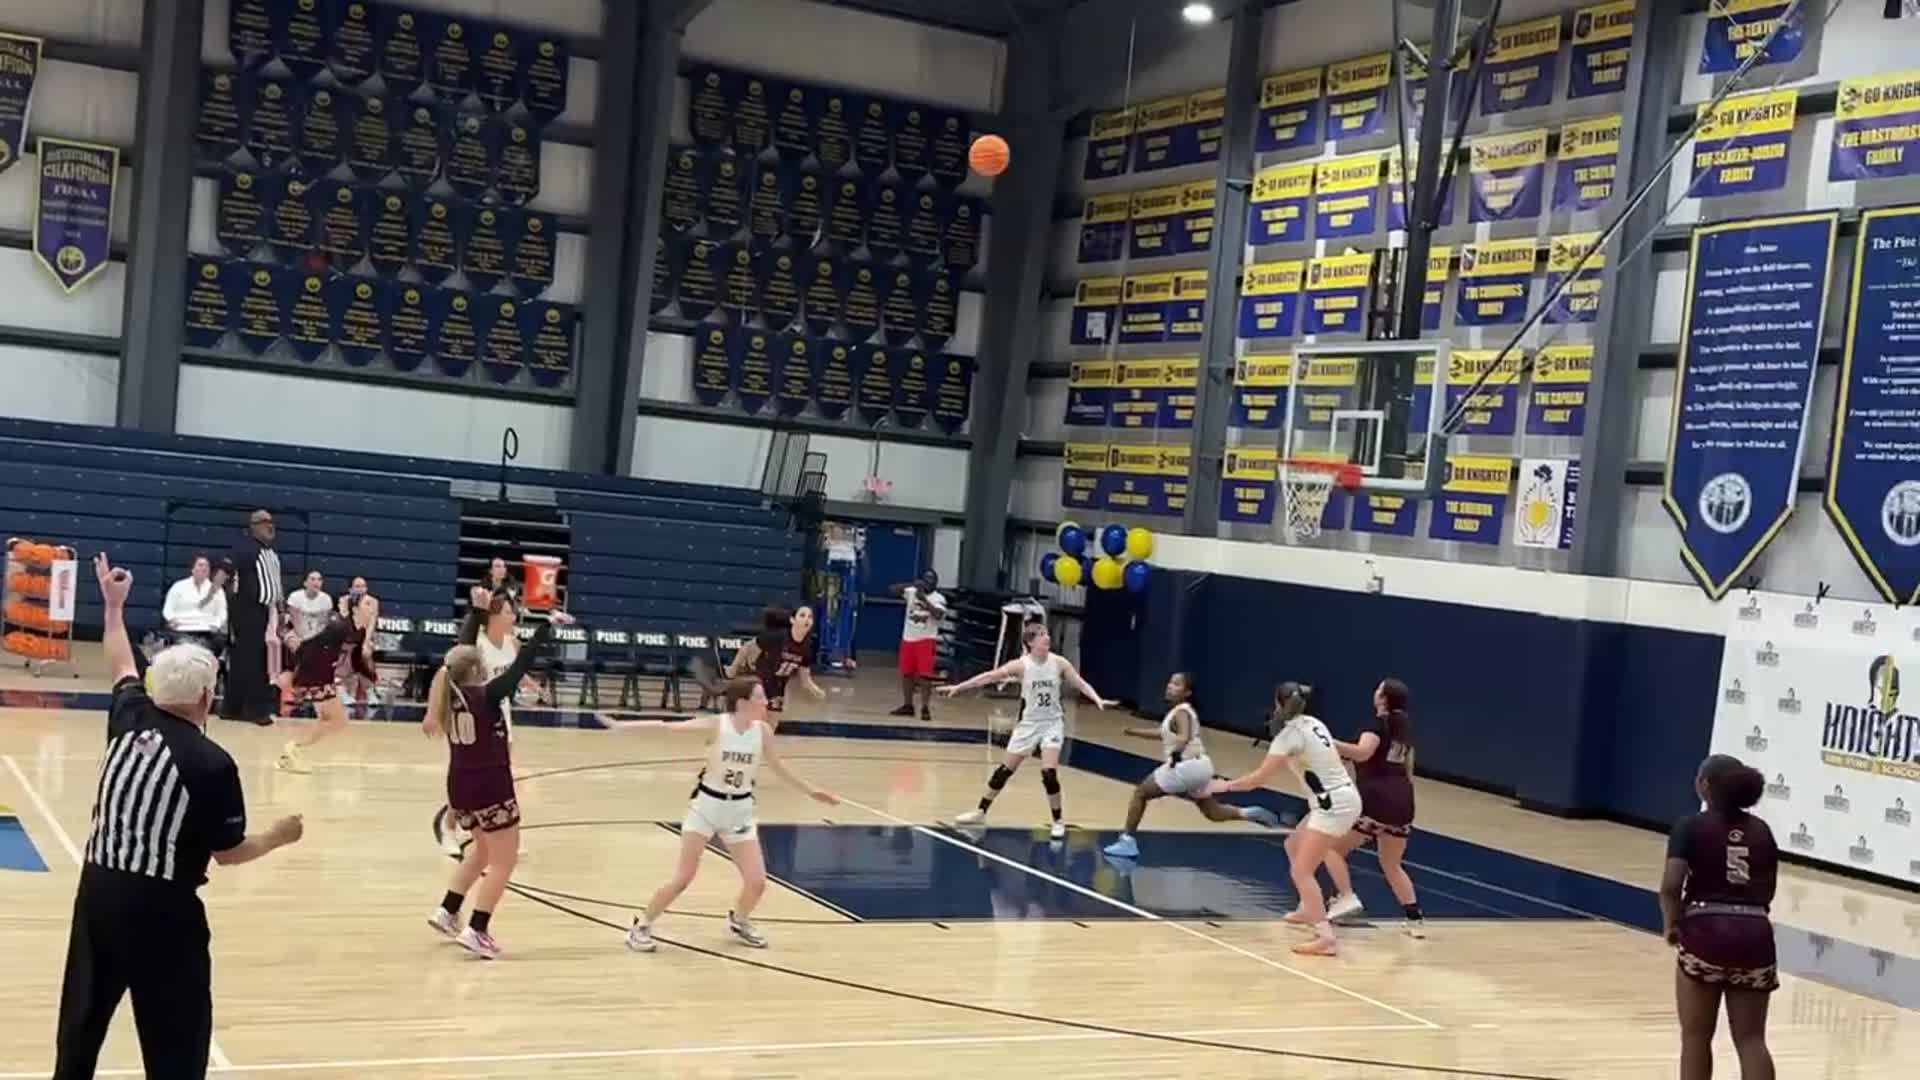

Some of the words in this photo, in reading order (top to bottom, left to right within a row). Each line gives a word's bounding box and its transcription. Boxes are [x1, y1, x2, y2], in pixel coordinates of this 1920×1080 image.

[1863, 87, 1881, 104] GO
[1883, 81, 1920, 102] KNIGH
[1719, 111, 1735, 126] GO
[1873, 237, 1892, 250] The
[1569, 357, 1591, 370] KNIG
[377, 618, 410, 632] PINE
[424, 621, 457, 635] PINE
[555, 629, 586, 641] PINE
[597, 631, 628, 644] PINE
[636, 633, 668, 646] PINE
[678, 635, 709, 649] PINE
[1037, 693, 1050, 706] 32
[722, 751, 752, 764] PINE
[1726, 846, 1751, 884] 5
